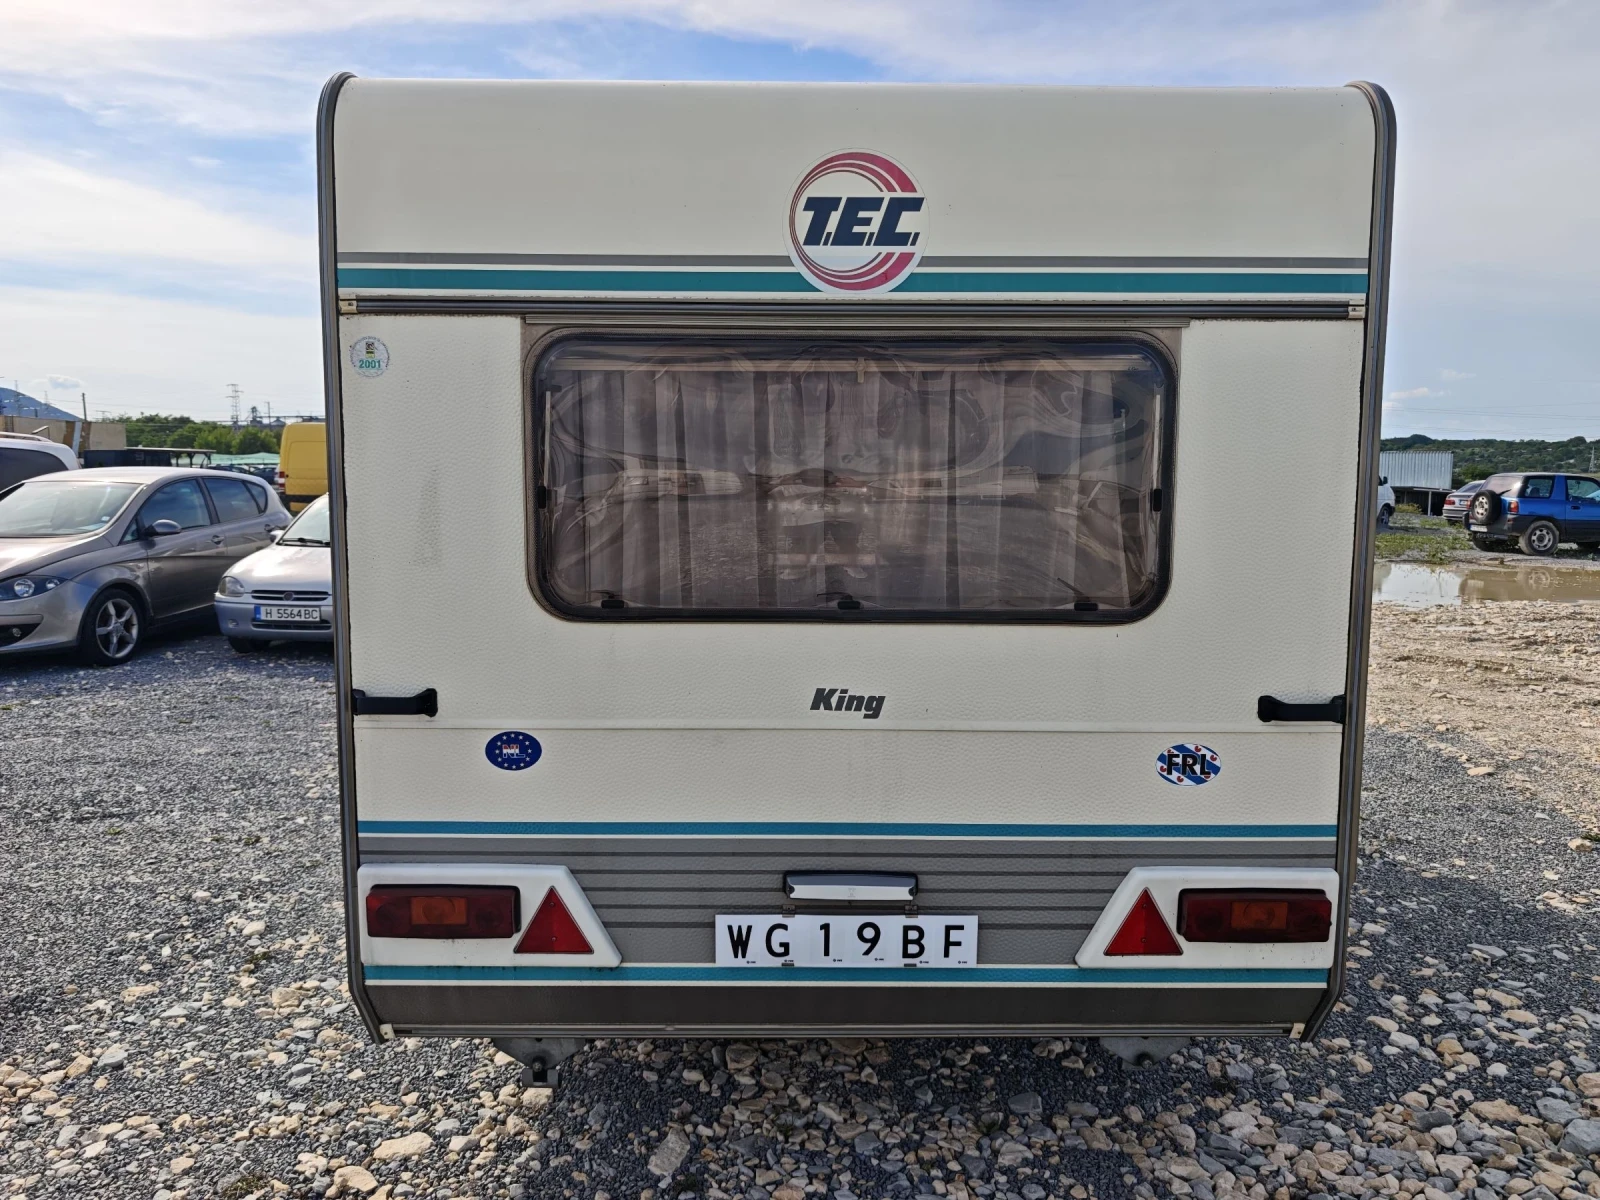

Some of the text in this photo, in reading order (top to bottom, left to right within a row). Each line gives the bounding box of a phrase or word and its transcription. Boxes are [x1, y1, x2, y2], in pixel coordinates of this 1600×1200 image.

[802, 196, 925, 247] T.E.C.
[358, 359, 381, 369] 2001
[265, 608, 273, 619] H
[810, 688, 886, 719] King
[502, 744, 526, 759] NL
[1166, 753, 1212, 776] FRL
